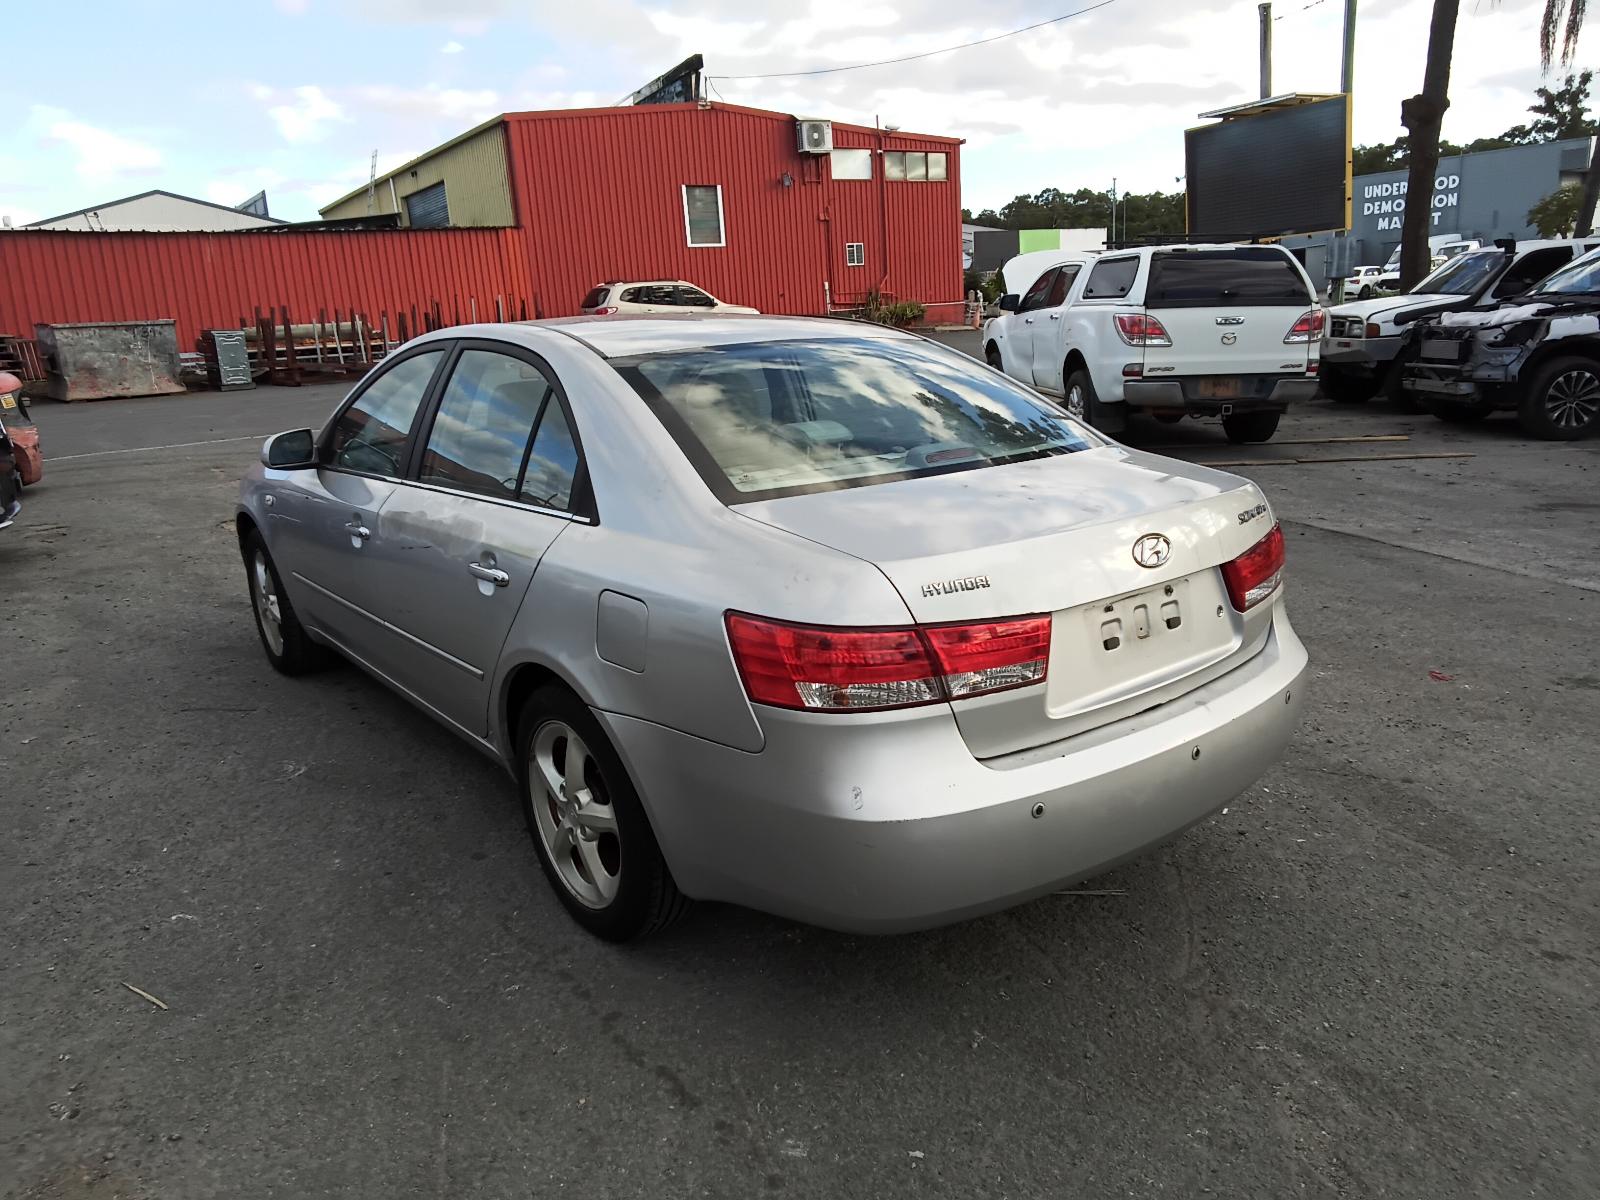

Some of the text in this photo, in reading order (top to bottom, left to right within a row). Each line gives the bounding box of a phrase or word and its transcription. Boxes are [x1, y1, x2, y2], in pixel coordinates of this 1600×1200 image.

[1364, 175, 1459, 199] UNDEROD
[1363, 193, 1458, 215] DEMOION
[1377, 212, 1441, 230] MAT
[921, 575, 990, 598] HYUNDAI
